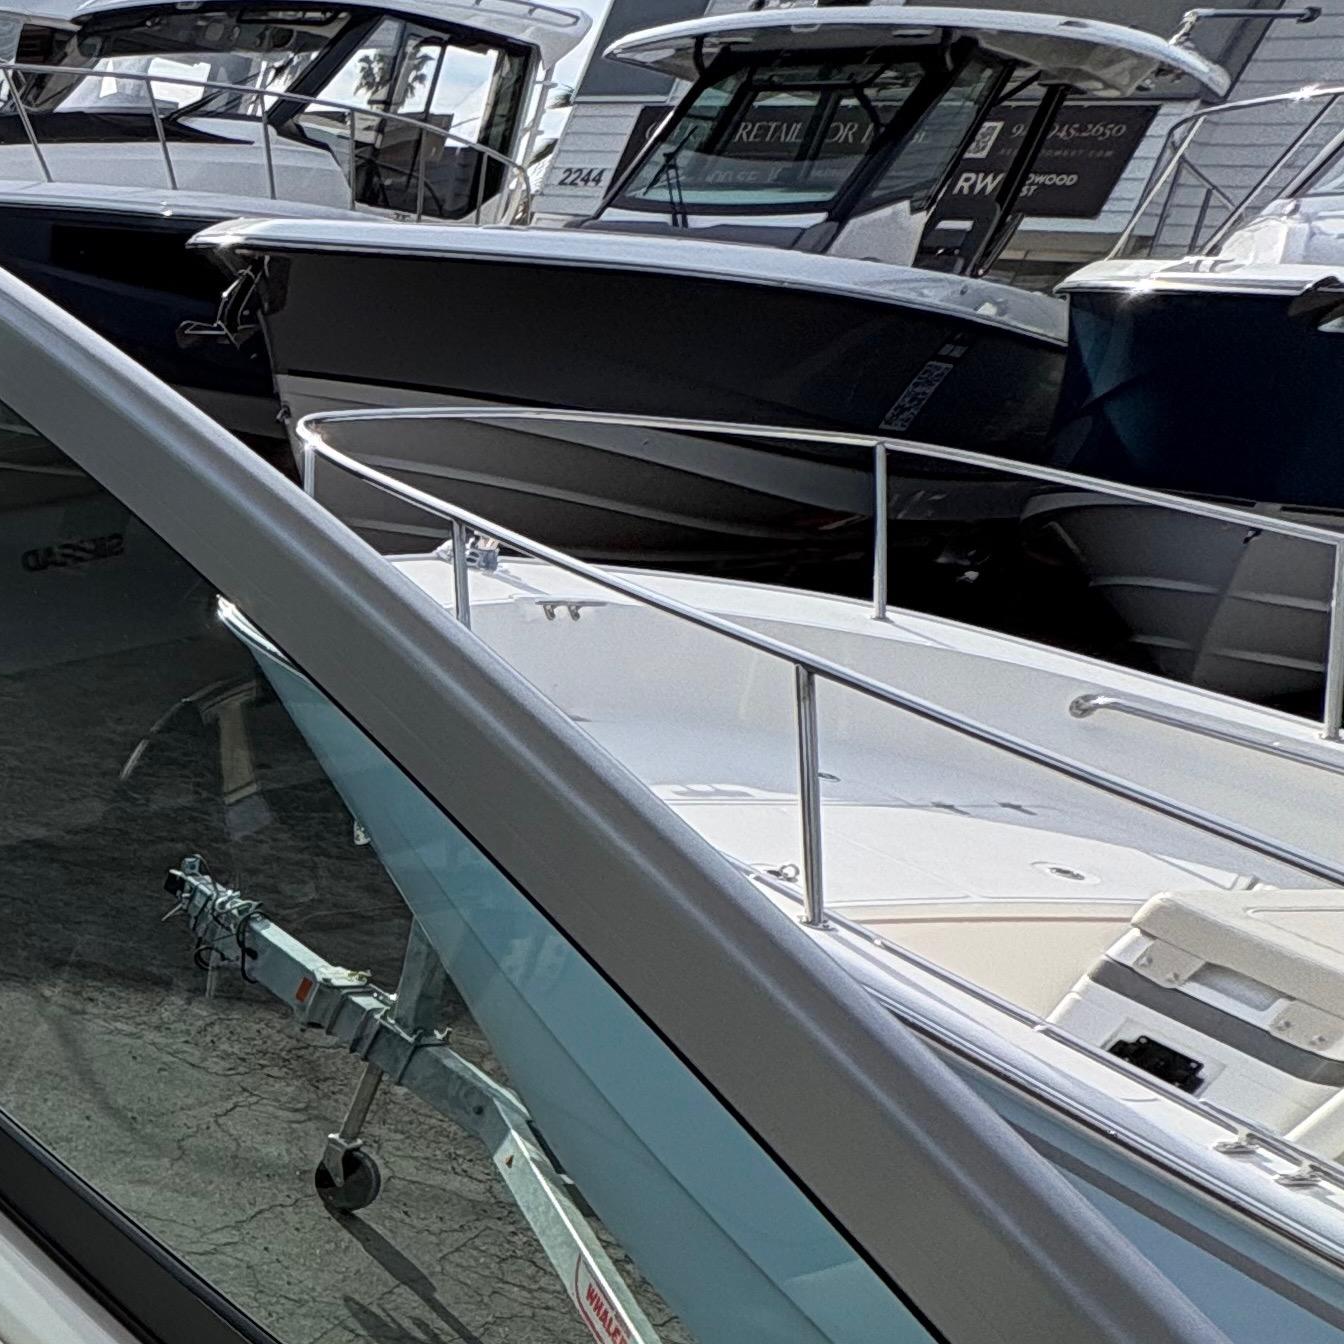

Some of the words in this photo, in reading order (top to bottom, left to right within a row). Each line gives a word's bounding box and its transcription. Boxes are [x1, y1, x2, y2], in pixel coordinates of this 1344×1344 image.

[733, 121, 804, 143] RETAIL
[558, 167, 607, 187] 2244
[953, 172, 1006, 196] RW
